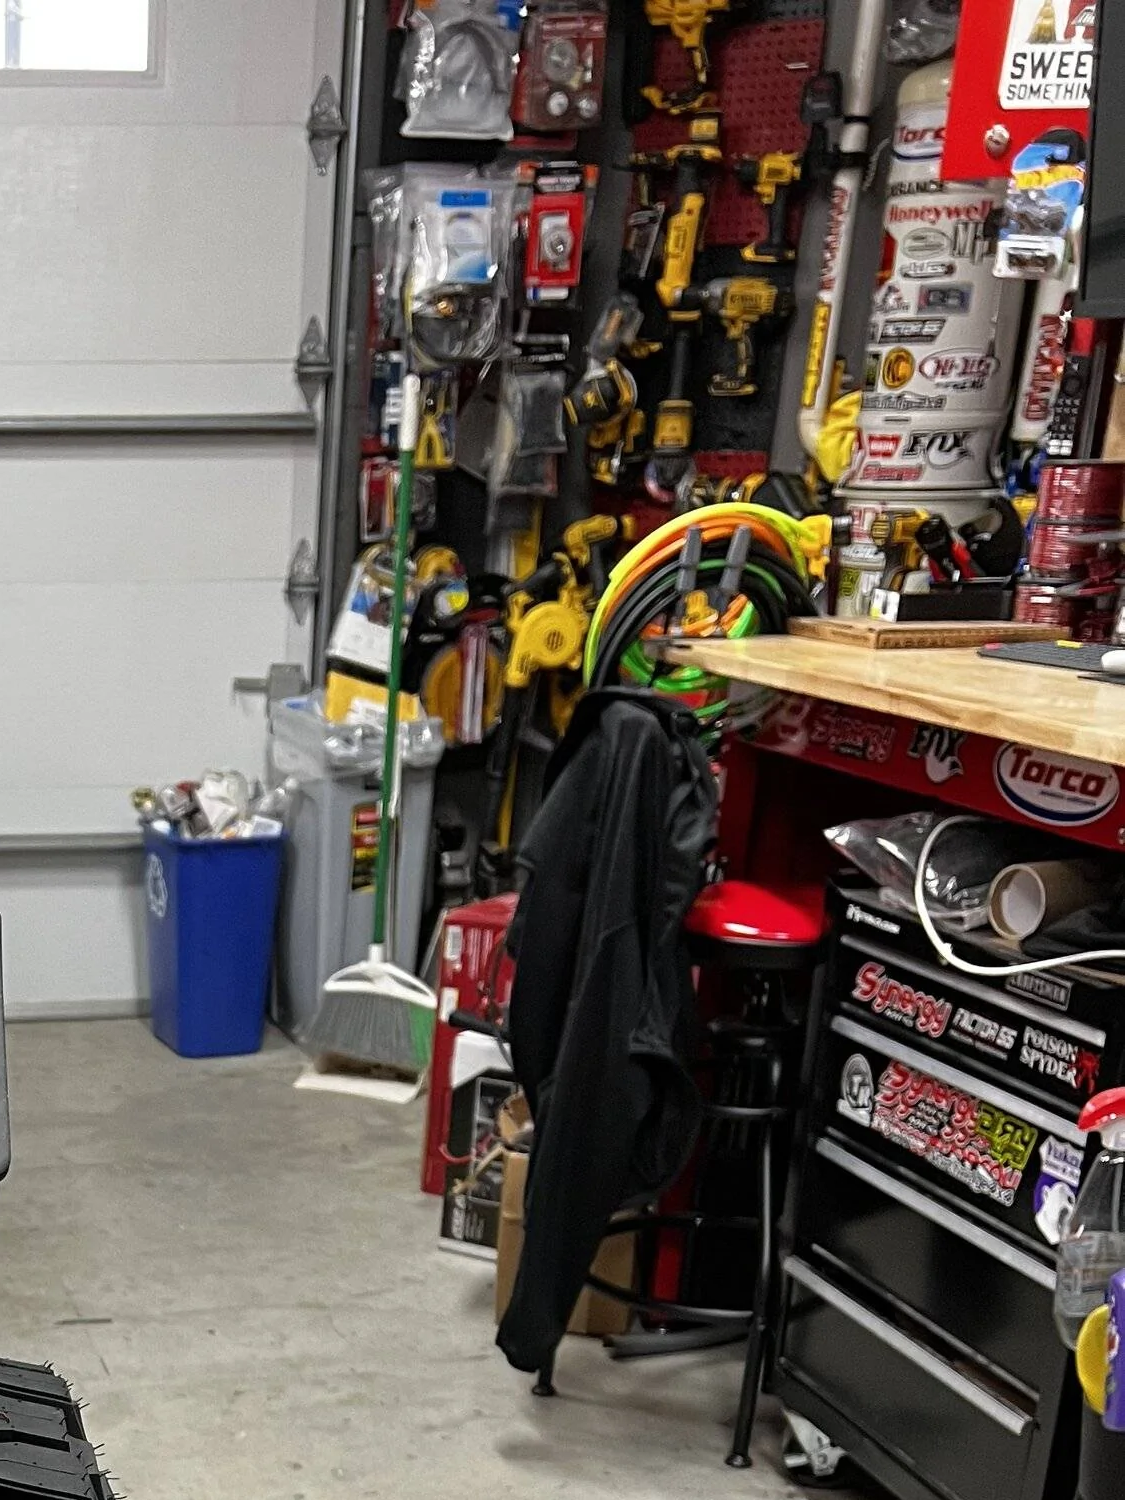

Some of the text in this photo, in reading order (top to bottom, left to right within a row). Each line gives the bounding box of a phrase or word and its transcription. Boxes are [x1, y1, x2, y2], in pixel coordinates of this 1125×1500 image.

[1010, 51, 1094, 79] SWEE
[1006, 83, 1091, 101] SOMETHIN
[898, 126, 945, 143] Torc
[889, 201, 993, 224] Honeywell
[1010, 748, 1108, 797] Torco
[852, 961, 952, 1038] Synergy
[1024, 1025, 1079, 1063] POISON
[1019, 1045, 1077, 1089] SPYDER
